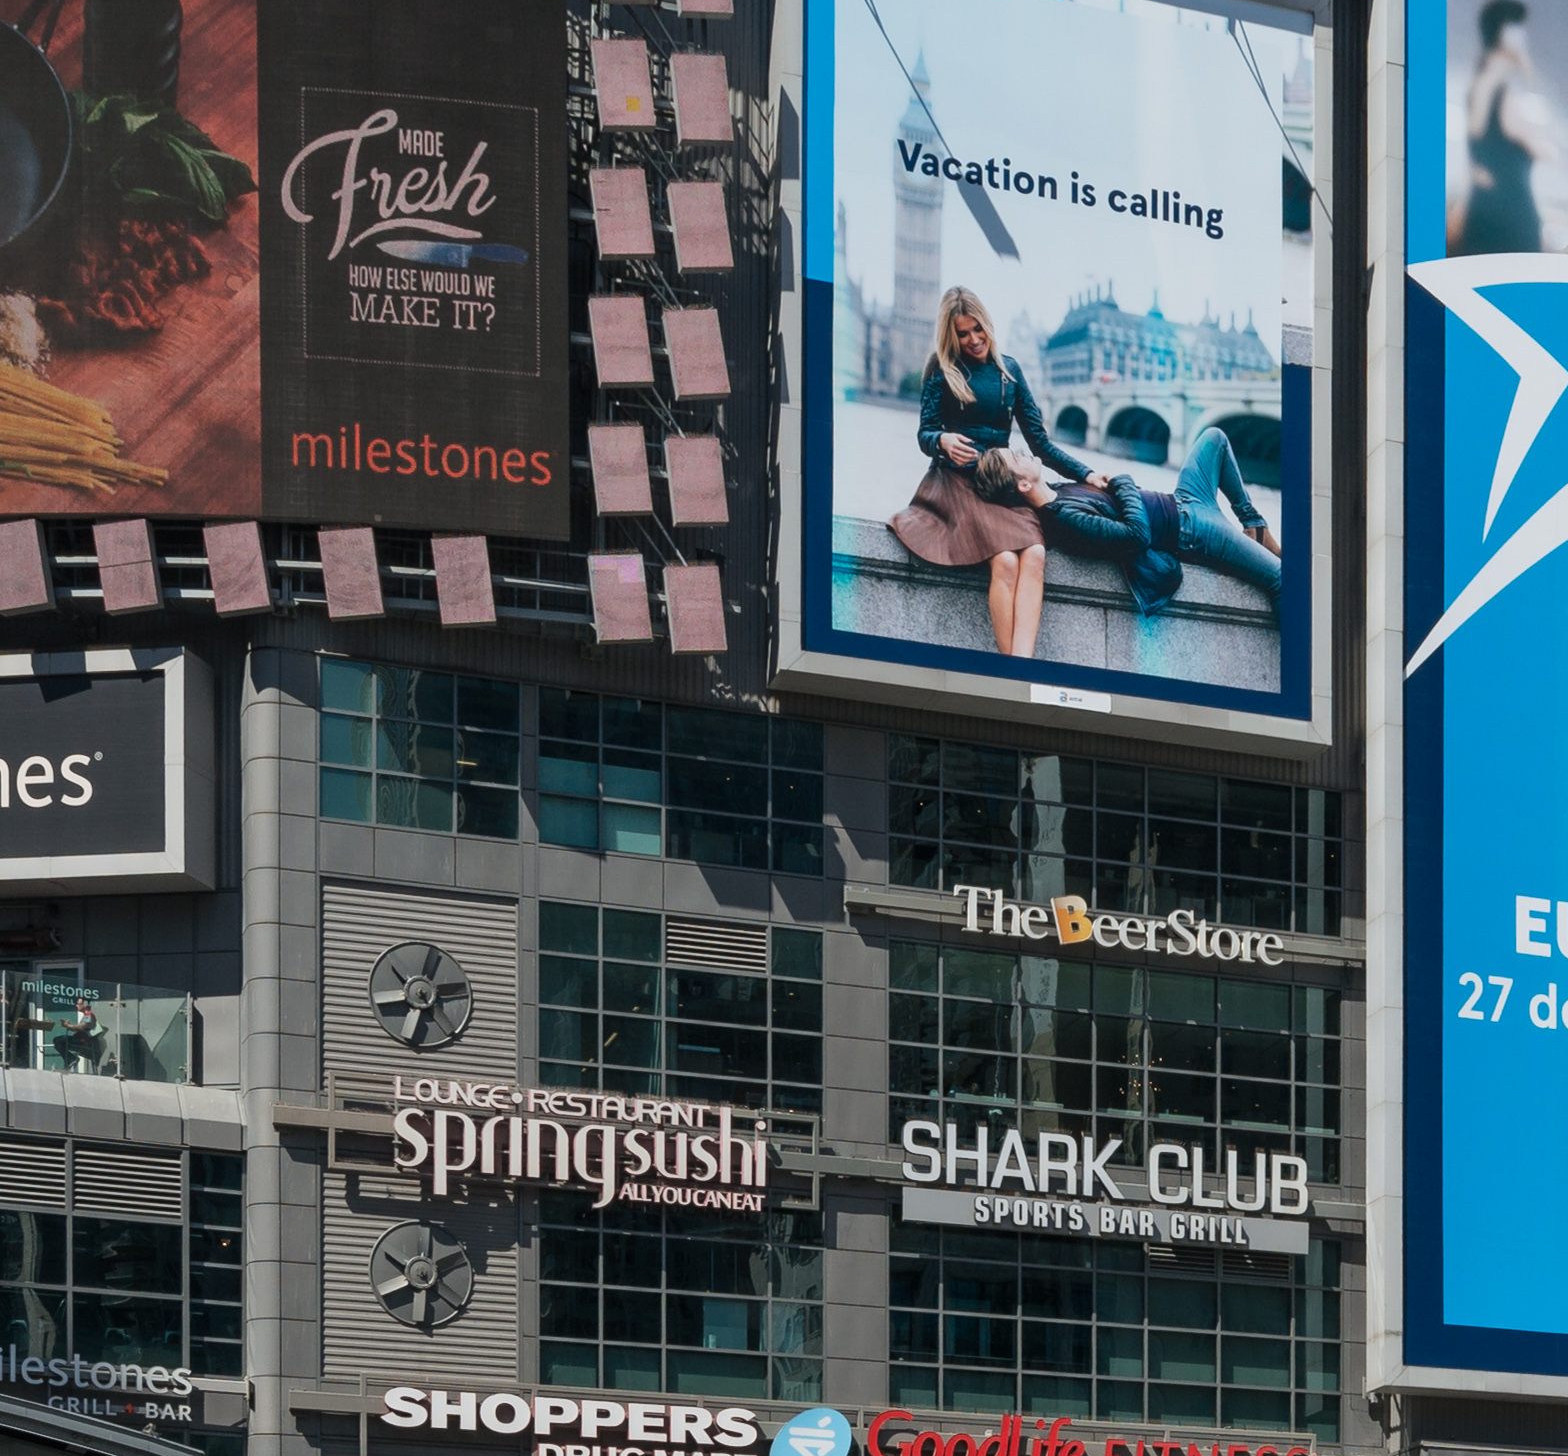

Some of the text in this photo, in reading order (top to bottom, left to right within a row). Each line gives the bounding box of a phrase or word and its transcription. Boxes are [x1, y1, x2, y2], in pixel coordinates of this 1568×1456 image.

[398, 128, 444, 158] MADE
[281, 108, 496, 261] Fresh
[897, 139, 1224, 240] Vacation is calling
[349, 263, 495, 298] HOW ELSE WOULD WE
[350, 293, 496, 331] MAKE IT?
[292, 424, 552, 485] milestones
[22, 979, 99, 1000] milestones
[1458, 971, 1513, 1024] 27
[395, 1075, 710, 1129] LOUNGE RESTAURANT
[902, 1121, 1309, 1216] SHARK CLUB
[974, 1194, 1248, 1246] SPORTS BAR GRILL
[47, 1395, 193, 1423] GRILL BAR
[382, 1387, 758, 1448] SHOPPERS
